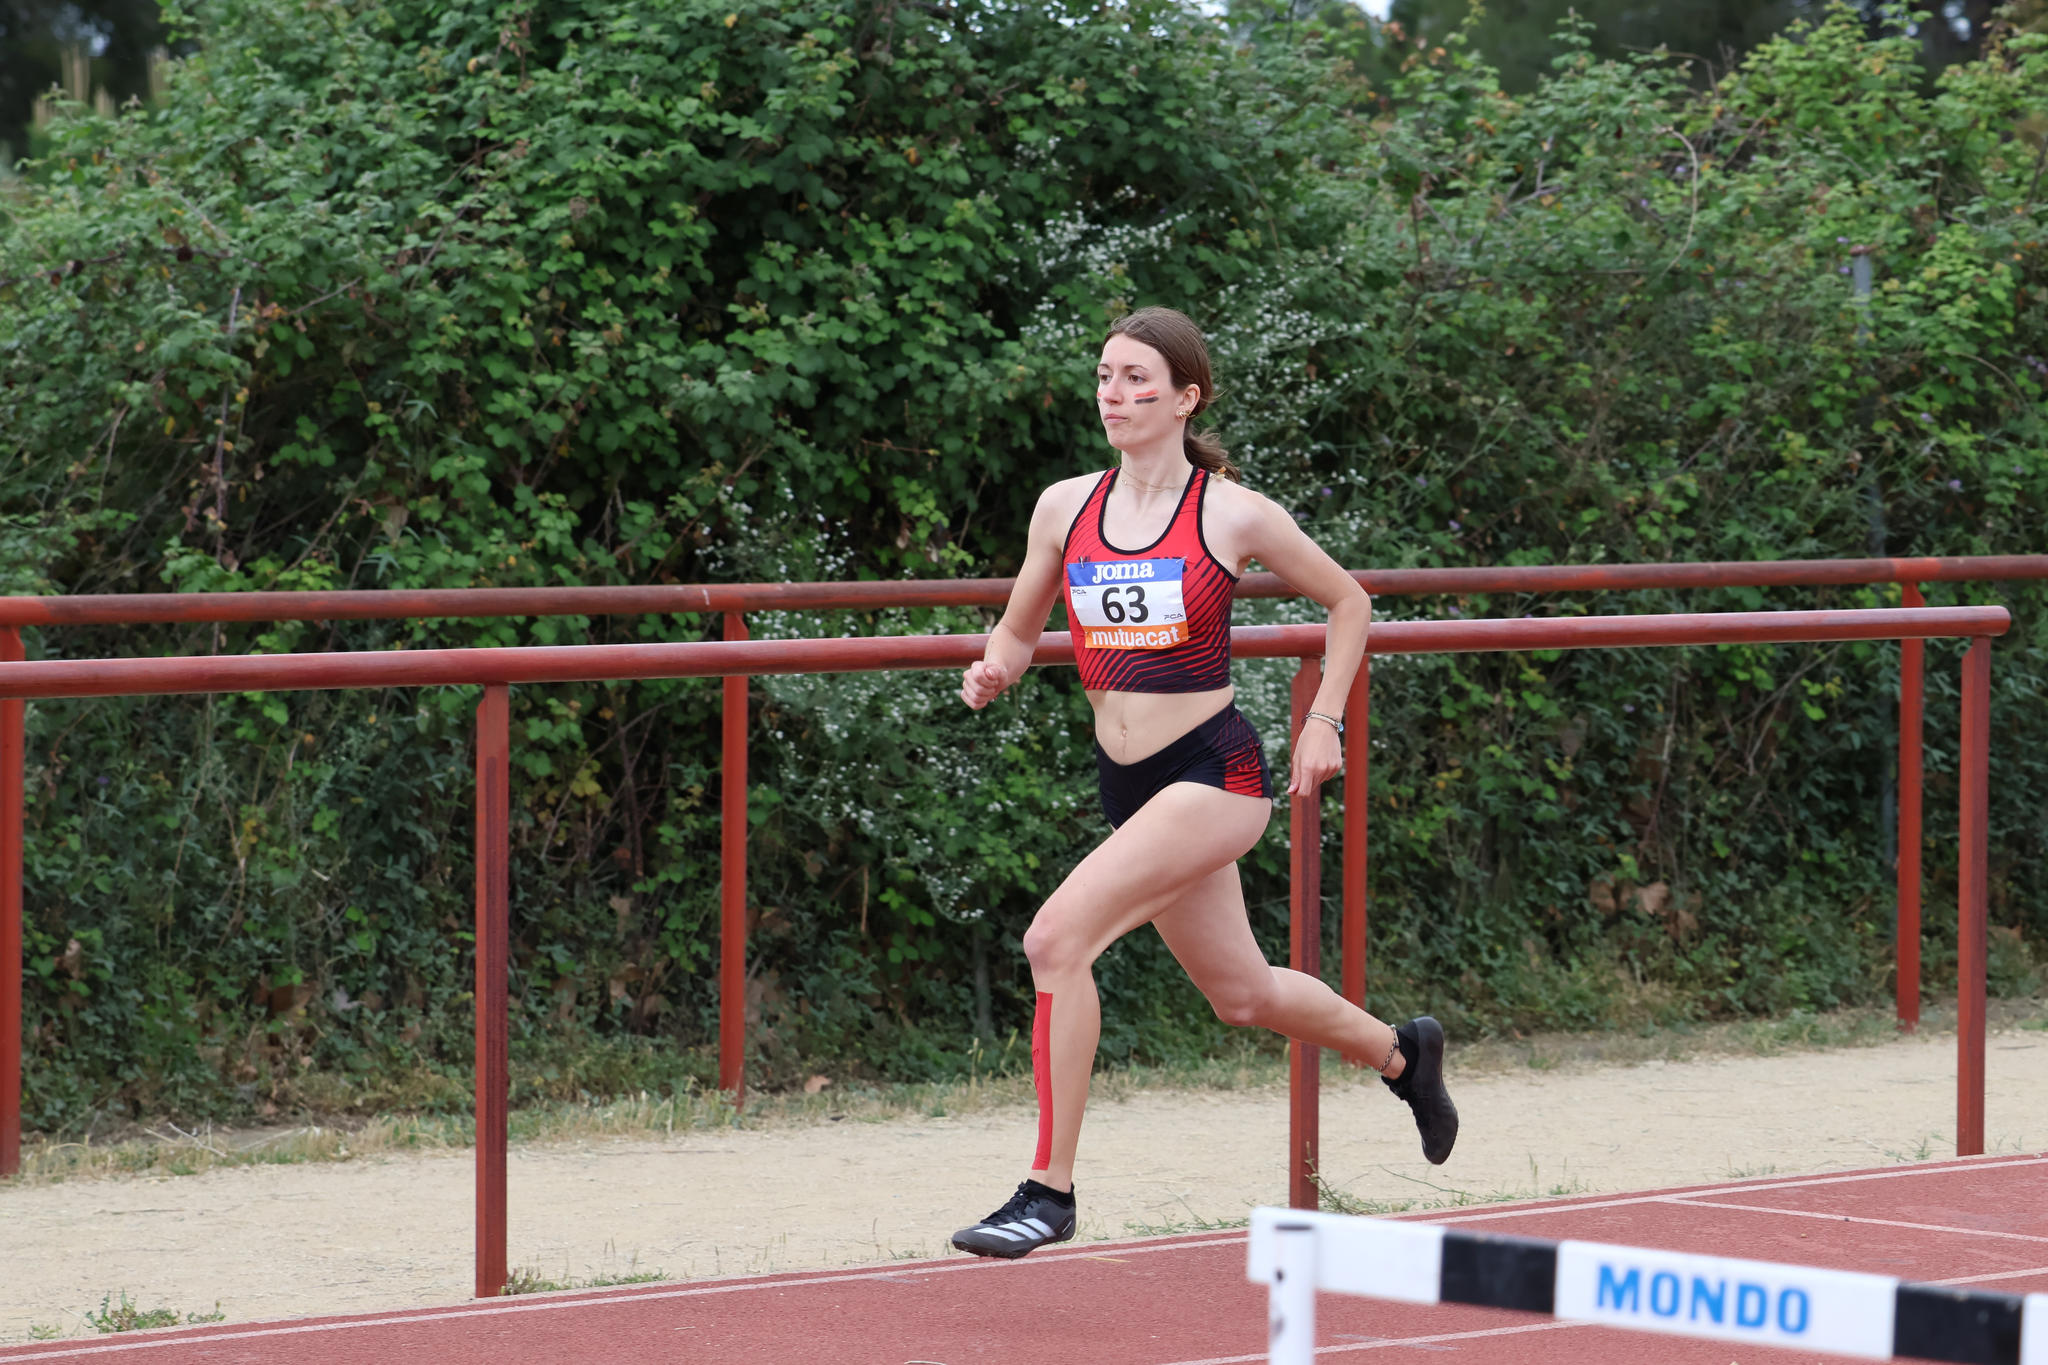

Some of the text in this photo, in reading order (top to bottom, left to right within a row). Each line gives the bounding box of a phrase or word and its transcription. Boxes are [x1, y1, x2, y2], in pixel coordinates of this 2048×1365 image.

[1101, 585, 1149, 624] 63
[1091, 626, 1180, 647] mutuacat
[1597, 1264, 1809, 1334] MONDO
